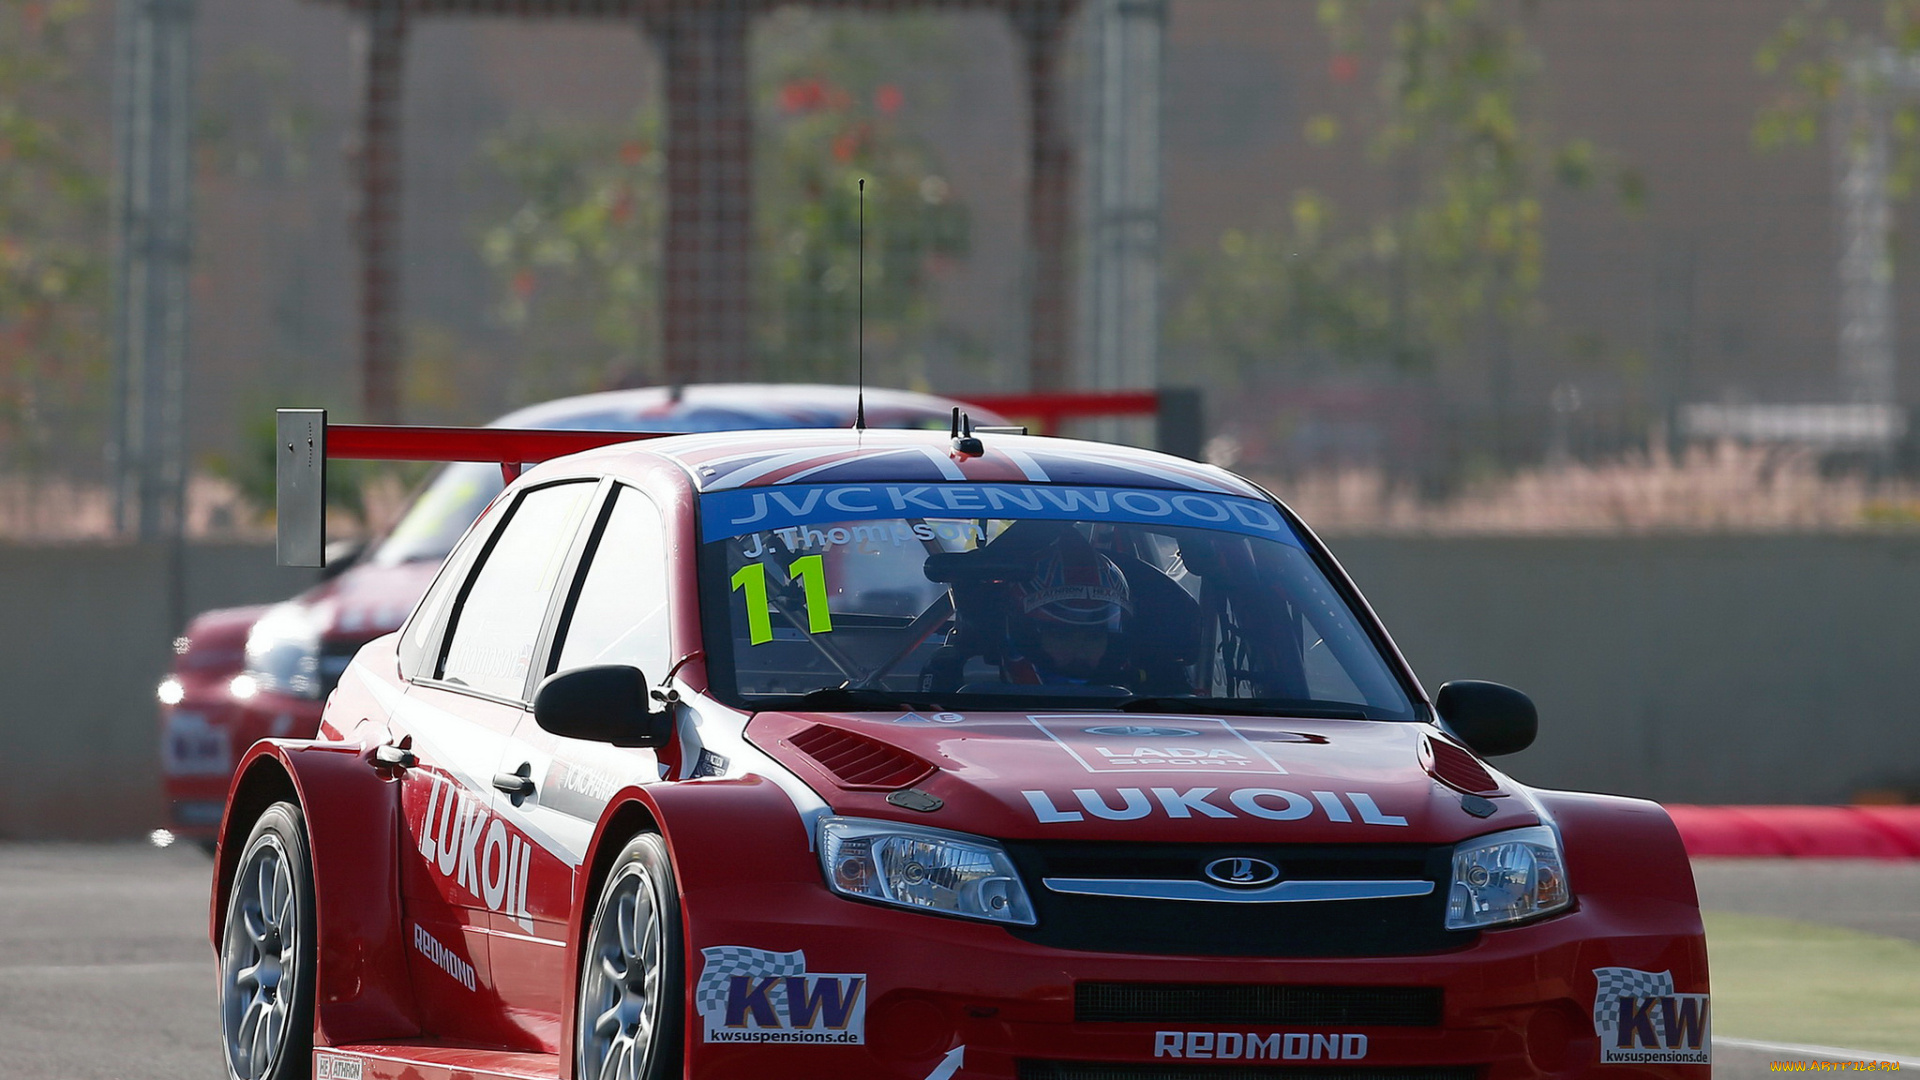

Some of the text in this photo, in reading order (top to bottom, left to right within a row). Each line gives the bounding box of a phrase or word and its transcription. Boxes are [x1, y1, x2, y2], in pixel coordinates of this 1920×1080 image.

[730, 554, 833, 646] 11
[1095, 747, 1247, 759] LADA
[1109, 758, 1252, 766] SPORT
[1021, 787, 1409, 827] LUKOIL
[420, 771, 534, 935] LUKOIL
[724, 976, 865, 1029] KW
[711, 1029, 858, 1043] kwsuspensions.de
[1616, 996, 1709, 1050] KW
[1606, 1050, 1708, 1063] kwsuspensions.de
